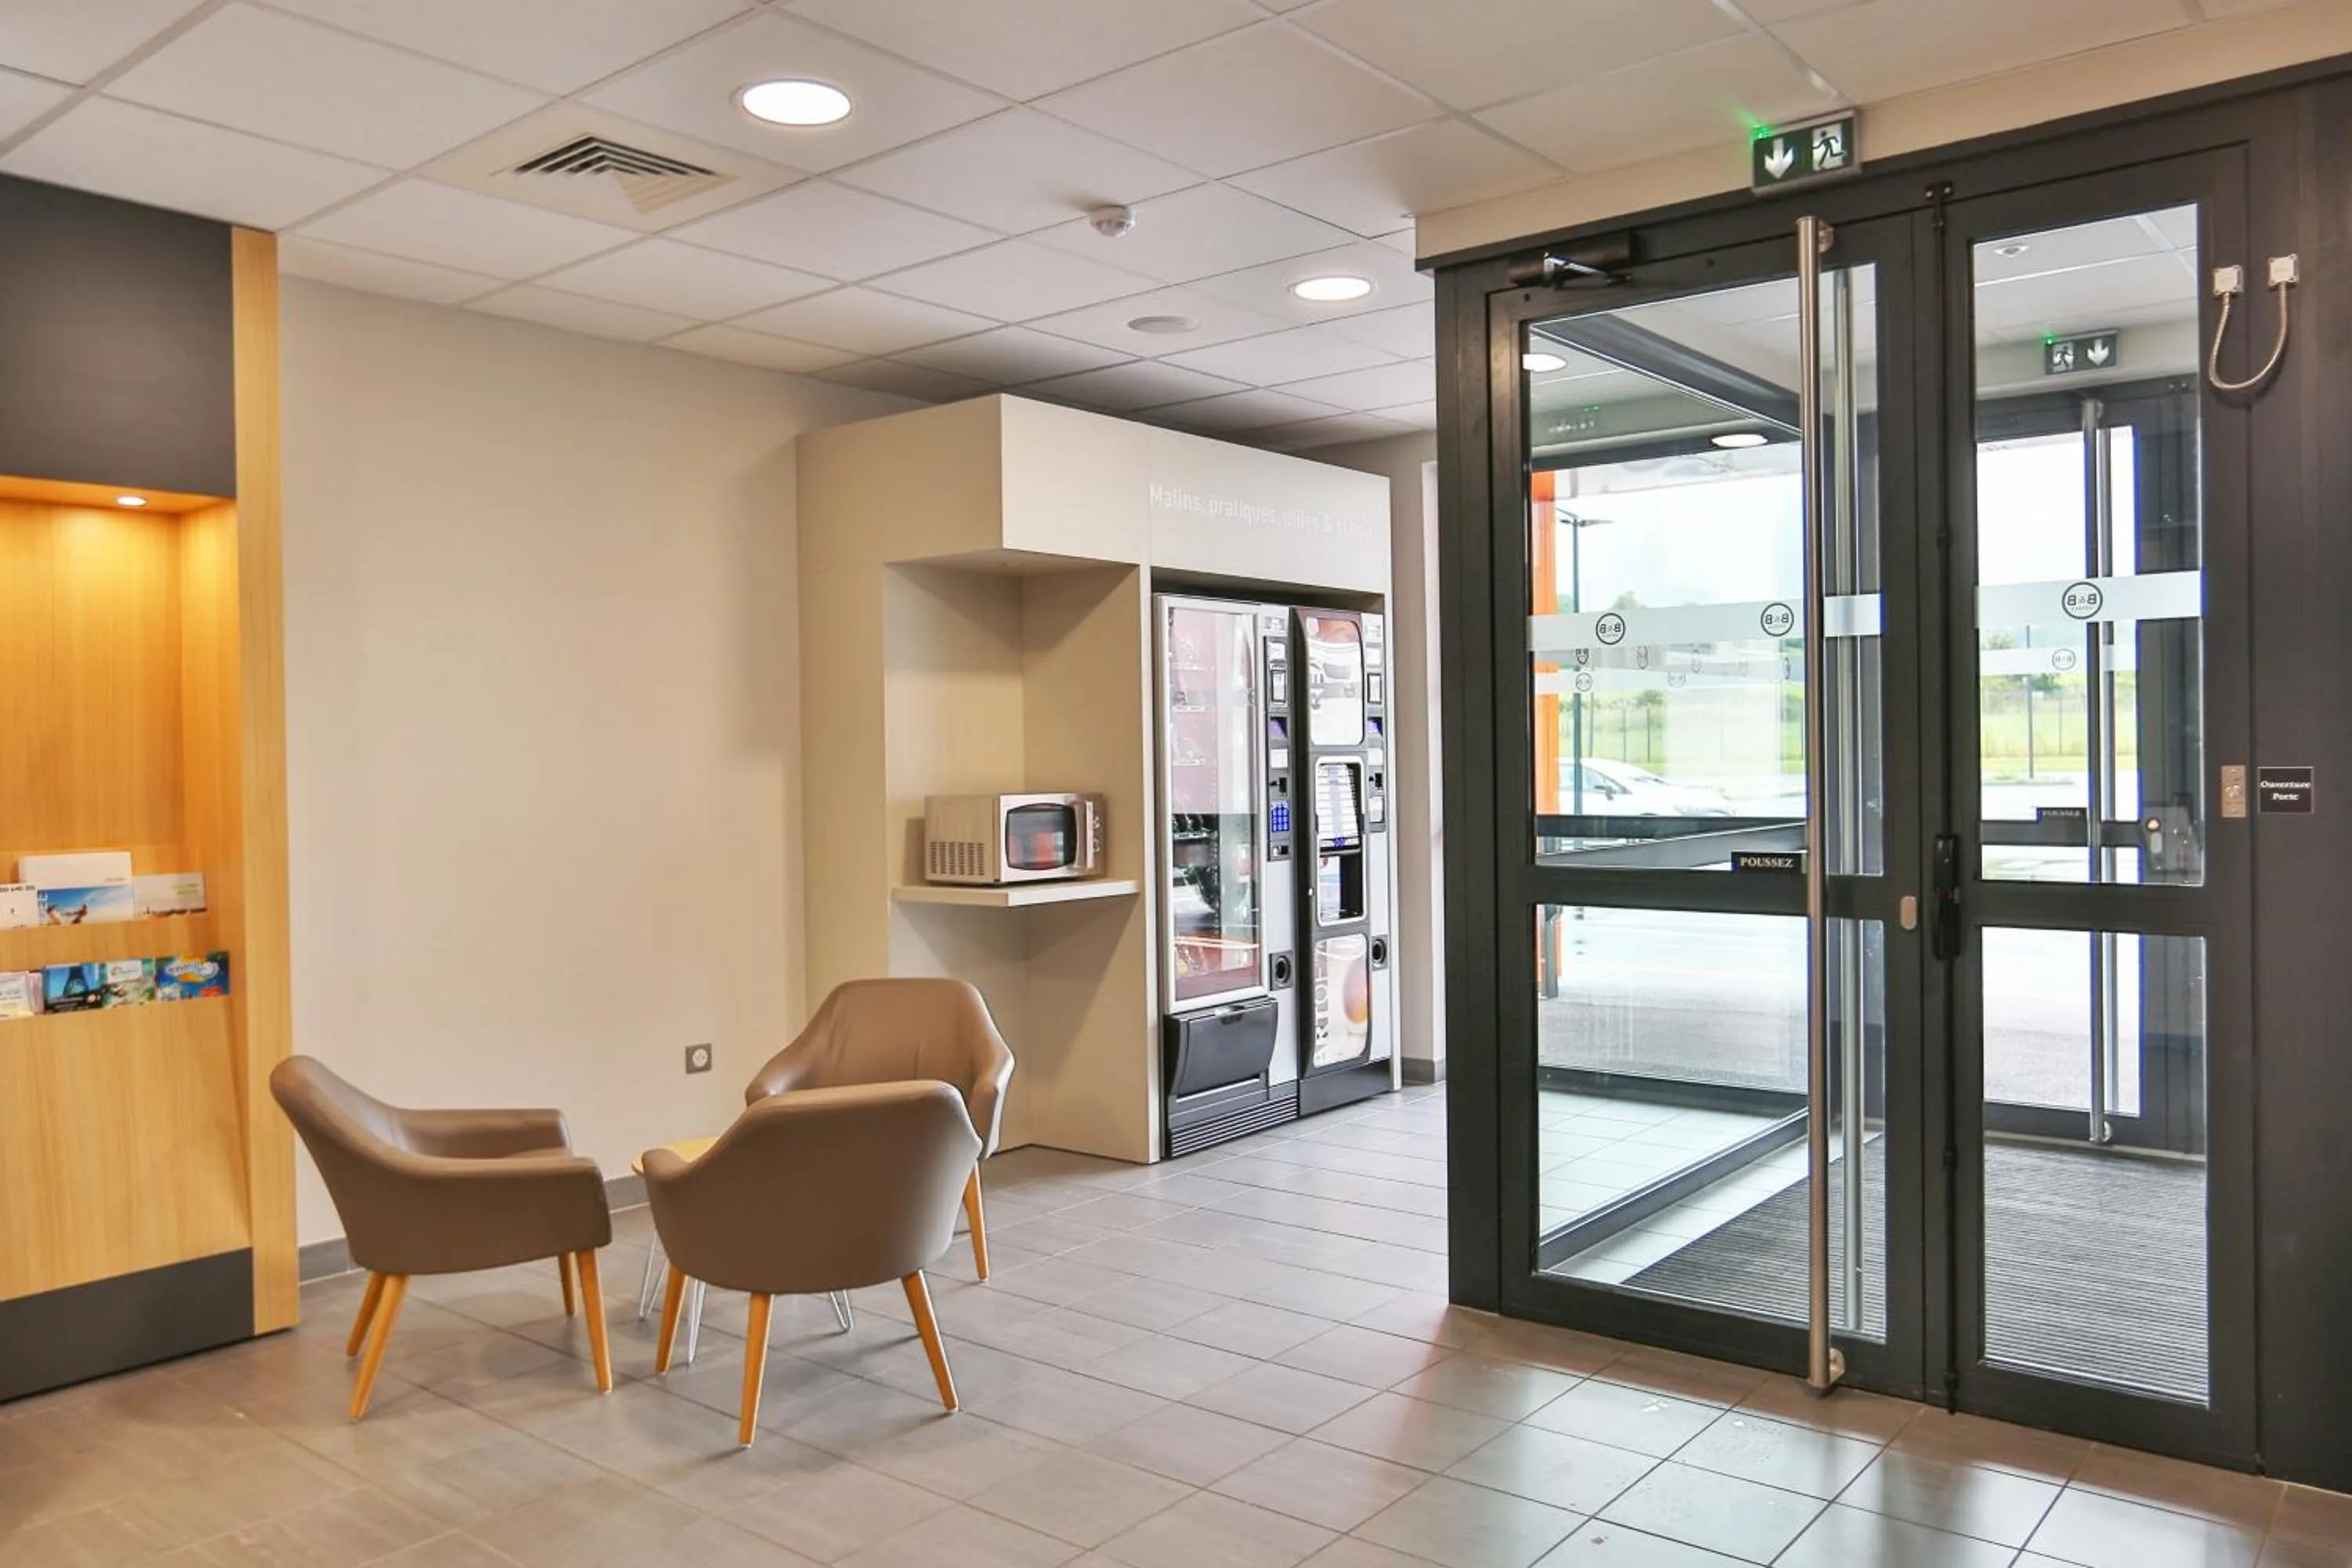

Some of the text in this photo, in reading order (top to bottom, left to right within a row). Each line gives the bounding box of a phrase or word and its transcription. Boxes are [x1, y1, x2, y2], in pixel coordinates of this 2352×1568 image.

[2259, 780, 2311, 789] Ouverture
[2271, 792, 2299, 801] Porte
[1740, 856, 1794, 868] POUSSEZ
